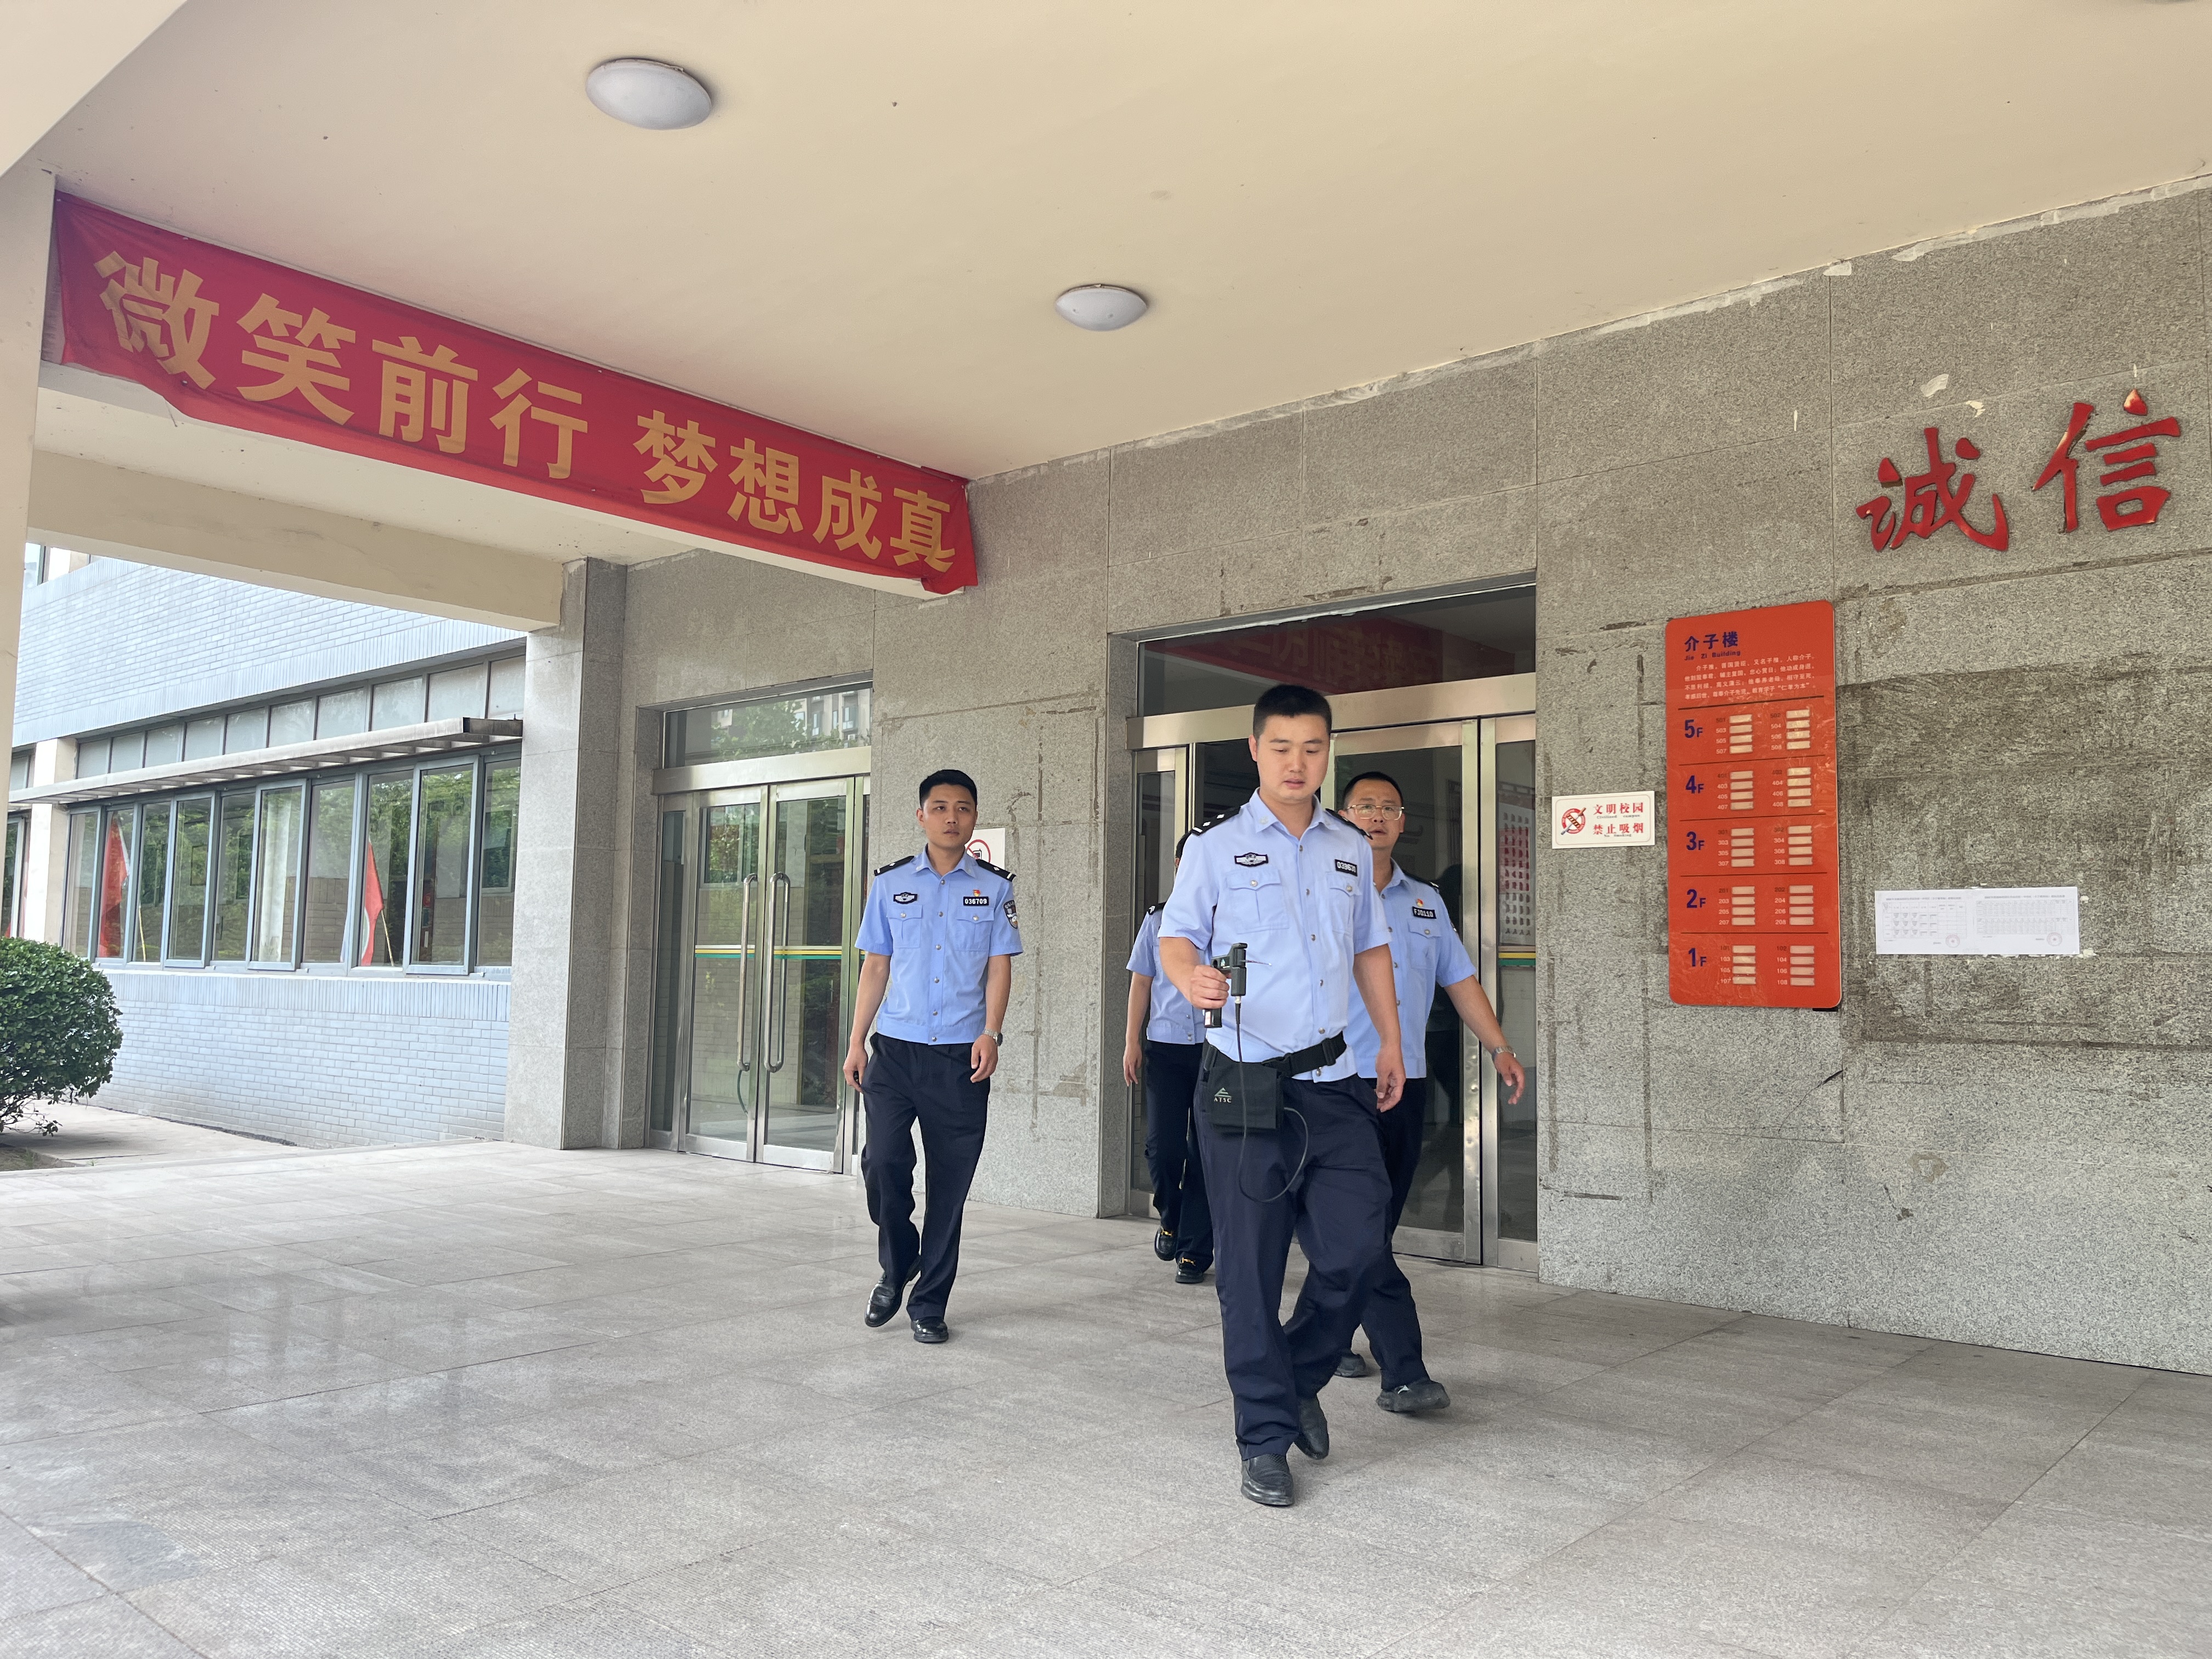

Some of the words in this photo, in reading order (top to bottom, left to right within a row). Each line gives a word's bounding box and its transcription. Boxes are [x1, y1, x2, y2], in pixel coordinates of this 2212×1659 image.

[94, 250, 588, 479] 微笑前行
[633, 409, 955, 572] 梦想成真
[1855, 388, 2180, 551] 诚信
[1684, 631, 1739, 652] 介子楼
[1685, 719, 1703, 738] 5F
[1685, 775, 1704, 794] 4F
[1593, 802, 1644, 815] 文明校园
[1593, 822, 1644, 835] 禁止吸烟
[1686, 831, 1705, 850] 3F
[1687, 889, 1706, 908] 2F
[1689, 948, 1707, 967] 1F
